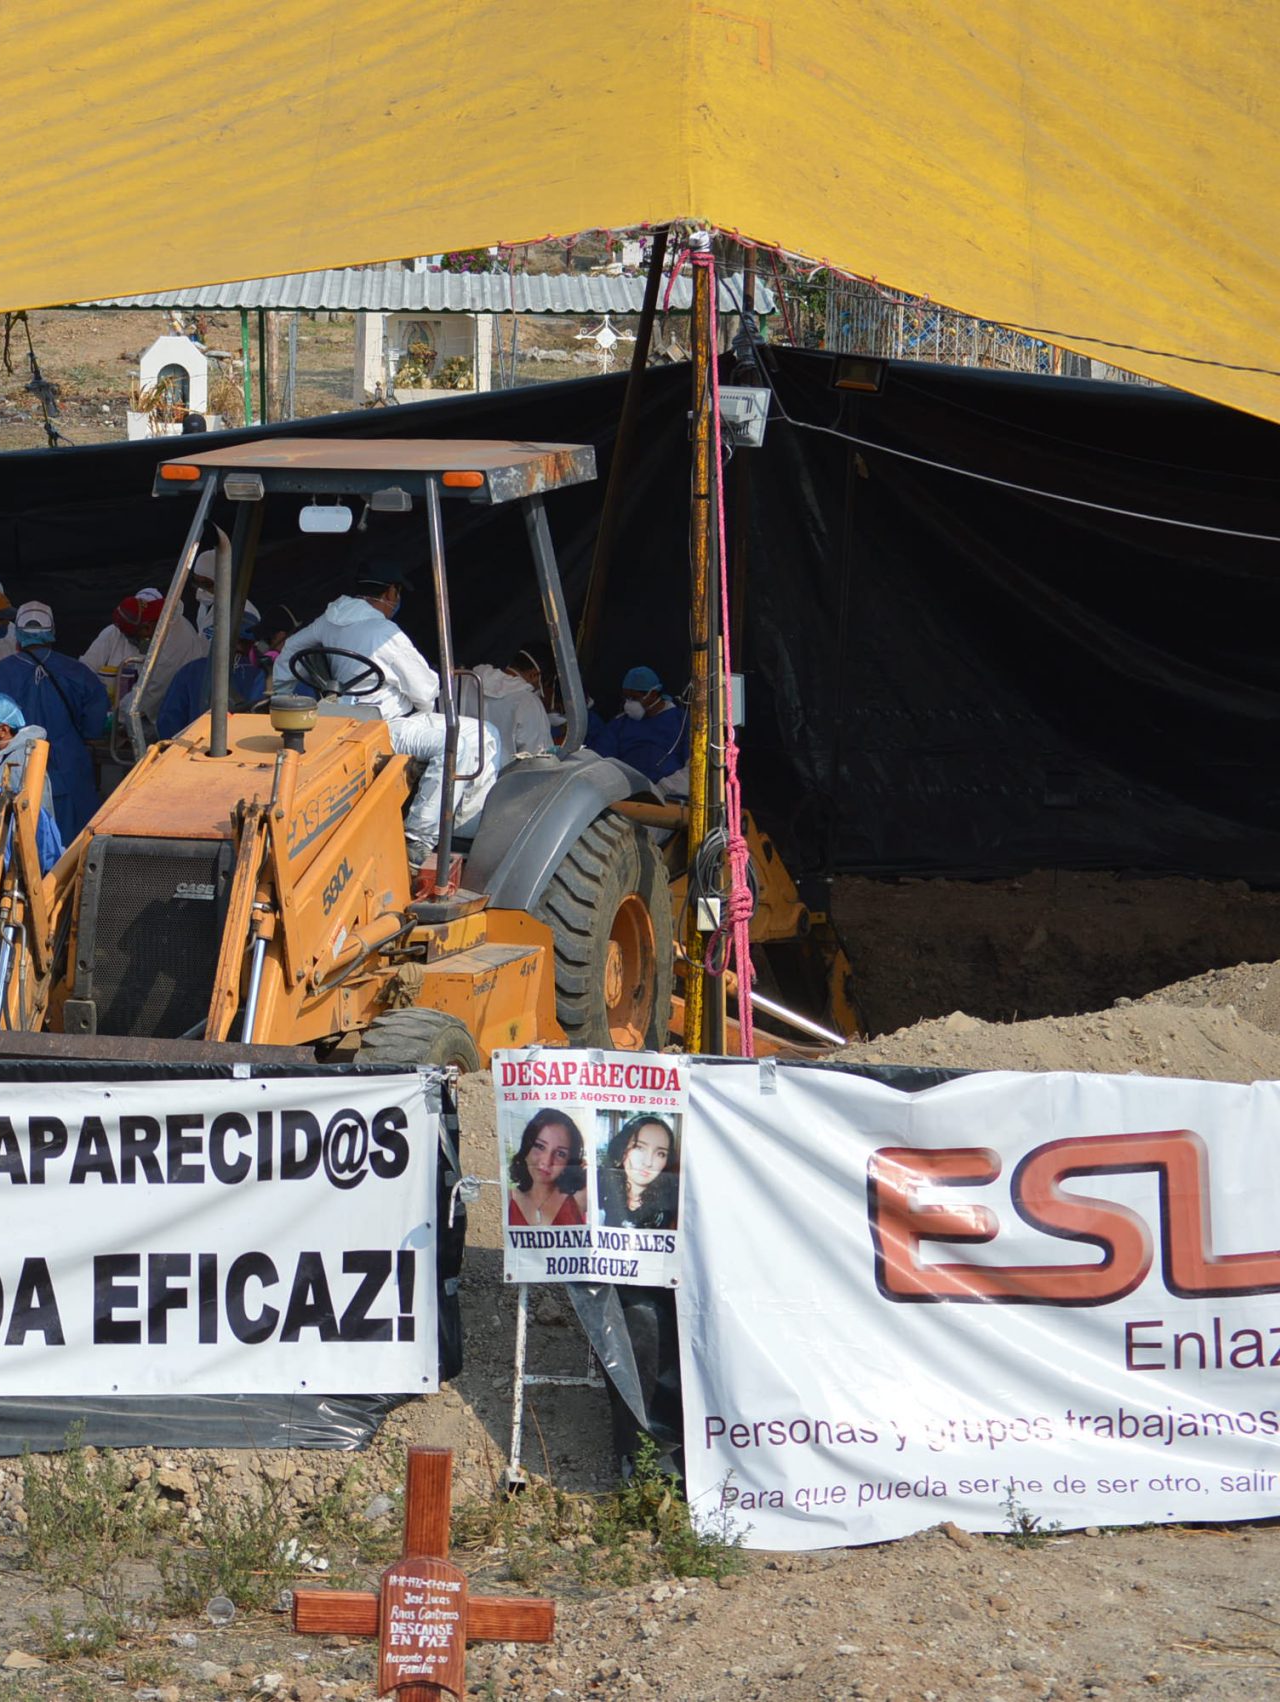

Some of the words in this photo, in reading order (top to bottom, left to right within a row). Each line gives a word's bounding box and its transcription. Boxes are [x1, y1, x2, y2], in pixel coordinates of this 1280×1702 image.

[176, 882, 216, 894] CASE
[501, 1061, 682, 1091] DESAPARECIDA
[504, 1093, 517, 1101] EL
[521, 1089, 540, 1101] DÍA
[545, 1092, 557, 1101] 12
[561, 1091, 577, 1101] DE
[580, 1092, 626, 1104] AGOSTO
[629, 1095, 646, 1105] DE
[650, 1097, 680, 1106] 2012.
[509, 1230, 593, 1249] VIRIDIANA
[597, 1230, 676, 1254] MORALES
[546, 1251, 639, 1277] RODRÍGUEZ
[93, 1250, 416, 1345] EFICAZ!
[705, 1415, 878, 1449] Personas
[890, 1420, 907, 1451] y
[926, 1416, 1053, 1451] grupos
[1065, 1407, 1279, 1445] trabajamos
[720, 1486, 784, 1511] Para
[795, 1484, 847, 1512] que
[858, 1475, 947, 1507] pueda
[958, 1478, 1001, 1494] ser
[1010, 1475, 1043, 1493] he
[1053, 1474, 1087, 1494] de
[1097, 1478, 1139, 1494] ser
[1148, 1473, 1209, 1495] otro,
[1220, 1468, 1279, 1492] salir
[404, 1591, 424, 1605] José
[390, 1621, 453, 1635] DESCANSE
[390, 1634, 411, 1645] EN
[418, 1635, 450, 1647] PAZ
[426, 1653, 436, 1663] de
[396, 1662, 433, 1676] Familia
